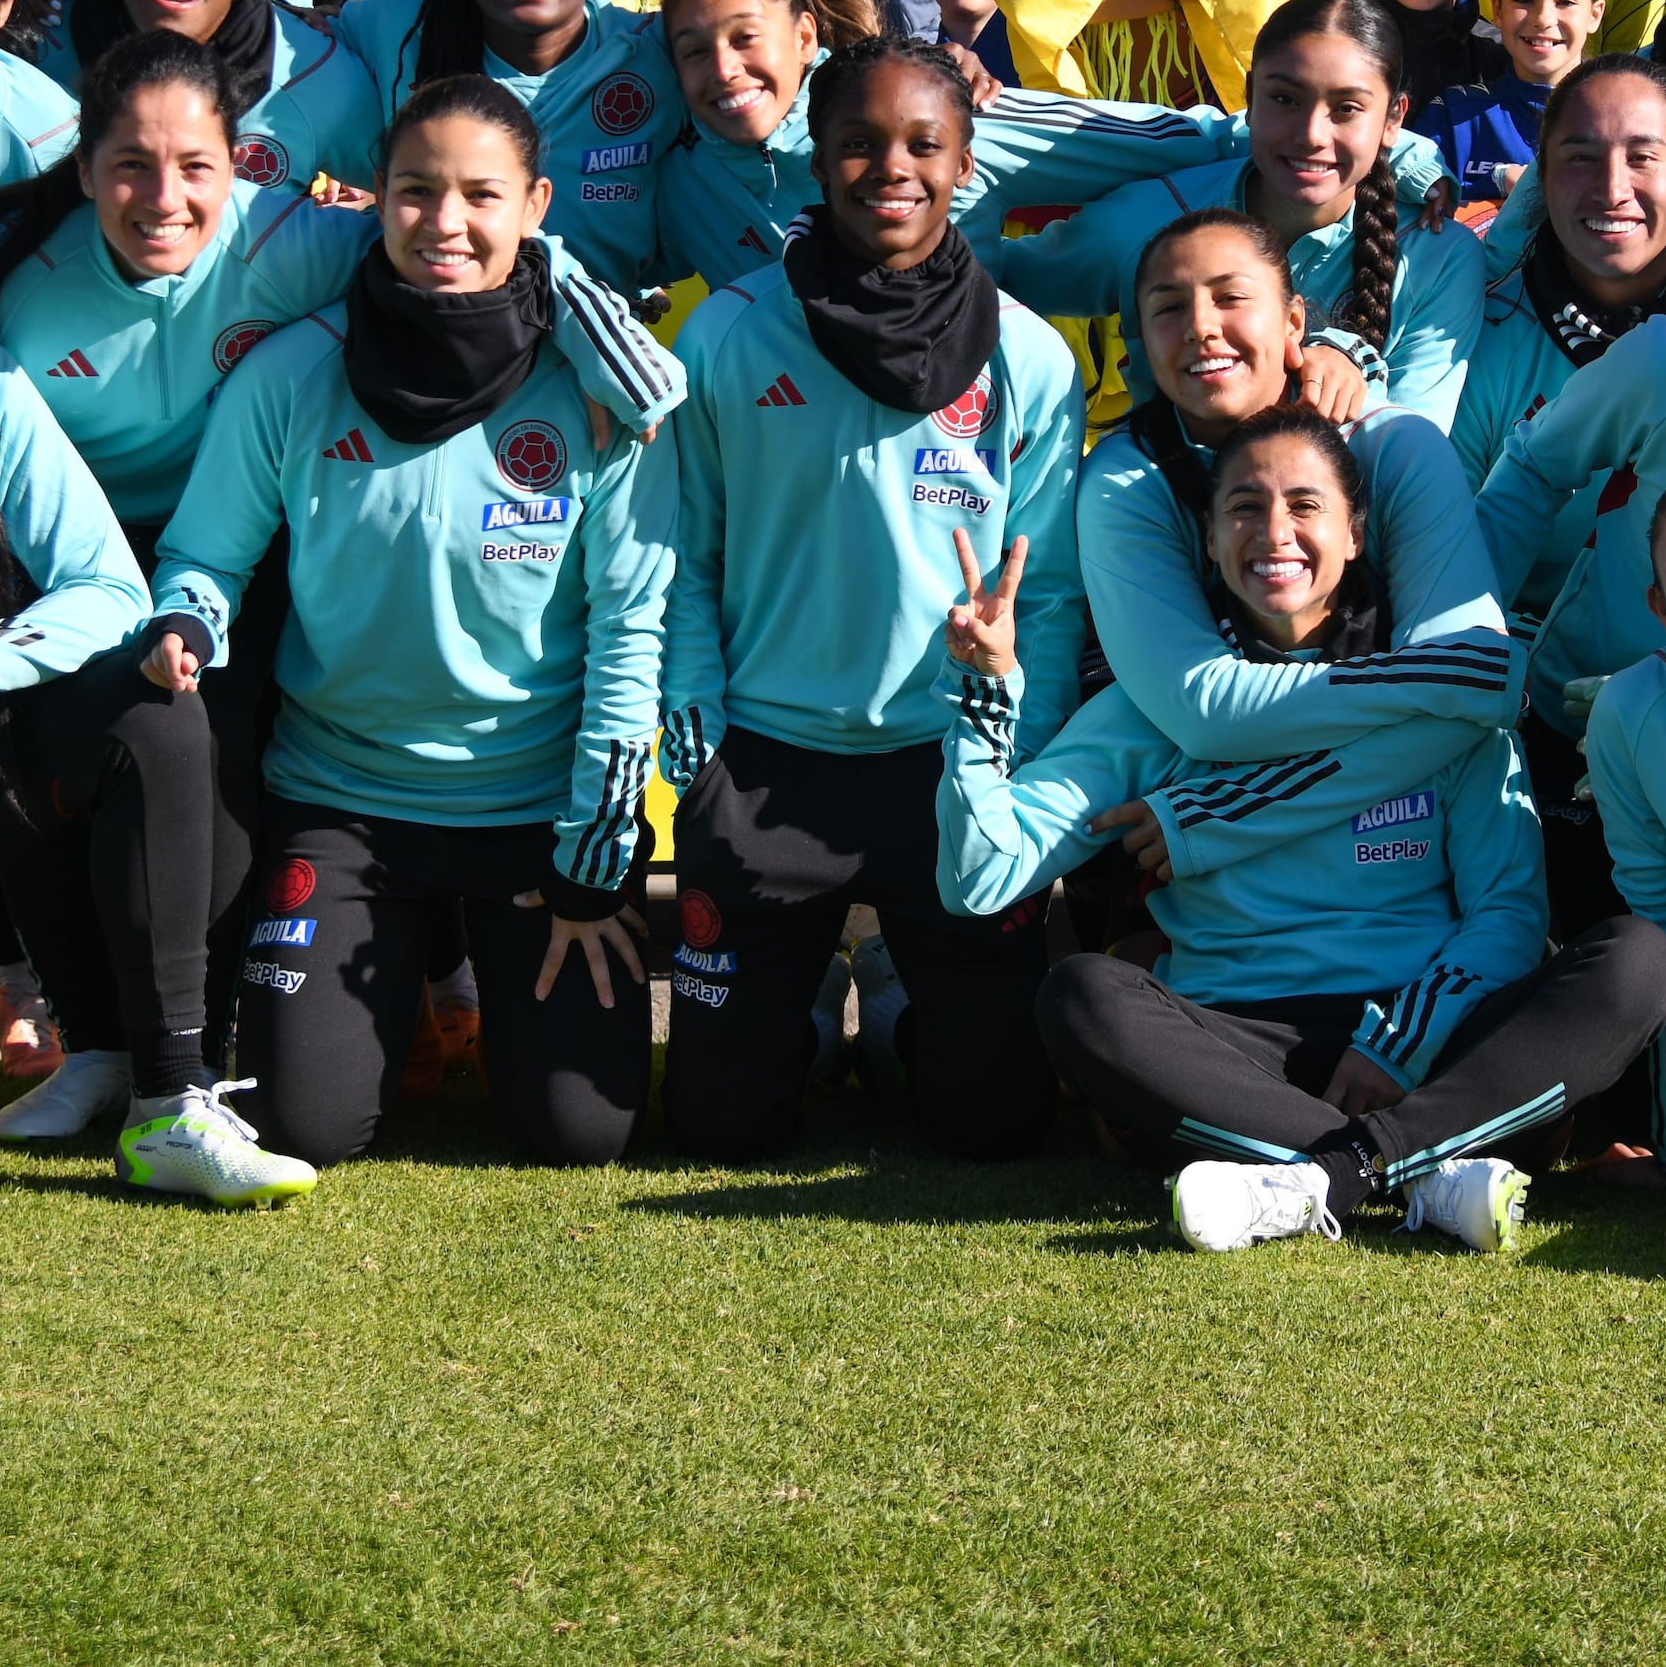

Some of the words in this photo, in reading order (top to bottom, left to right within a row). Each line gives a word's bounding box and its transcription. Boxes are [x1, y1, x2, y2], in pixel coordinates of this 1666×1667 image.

[586, 144, 649, 173] AGUILA
[919, 450, 990, 473] AGUILA
[486, 498, 564, 530] AGUILA
[911, 484, 991, 515] BetPlay
[481, 541, 561, 563] BetPlay
[1356, 795, 1429, 832] AGUILA
[1355, 838, 1431, 864] BetPlay
[251, 919, 308, 945] AGUILA
[674, 943, 732, 973] AGUILA
